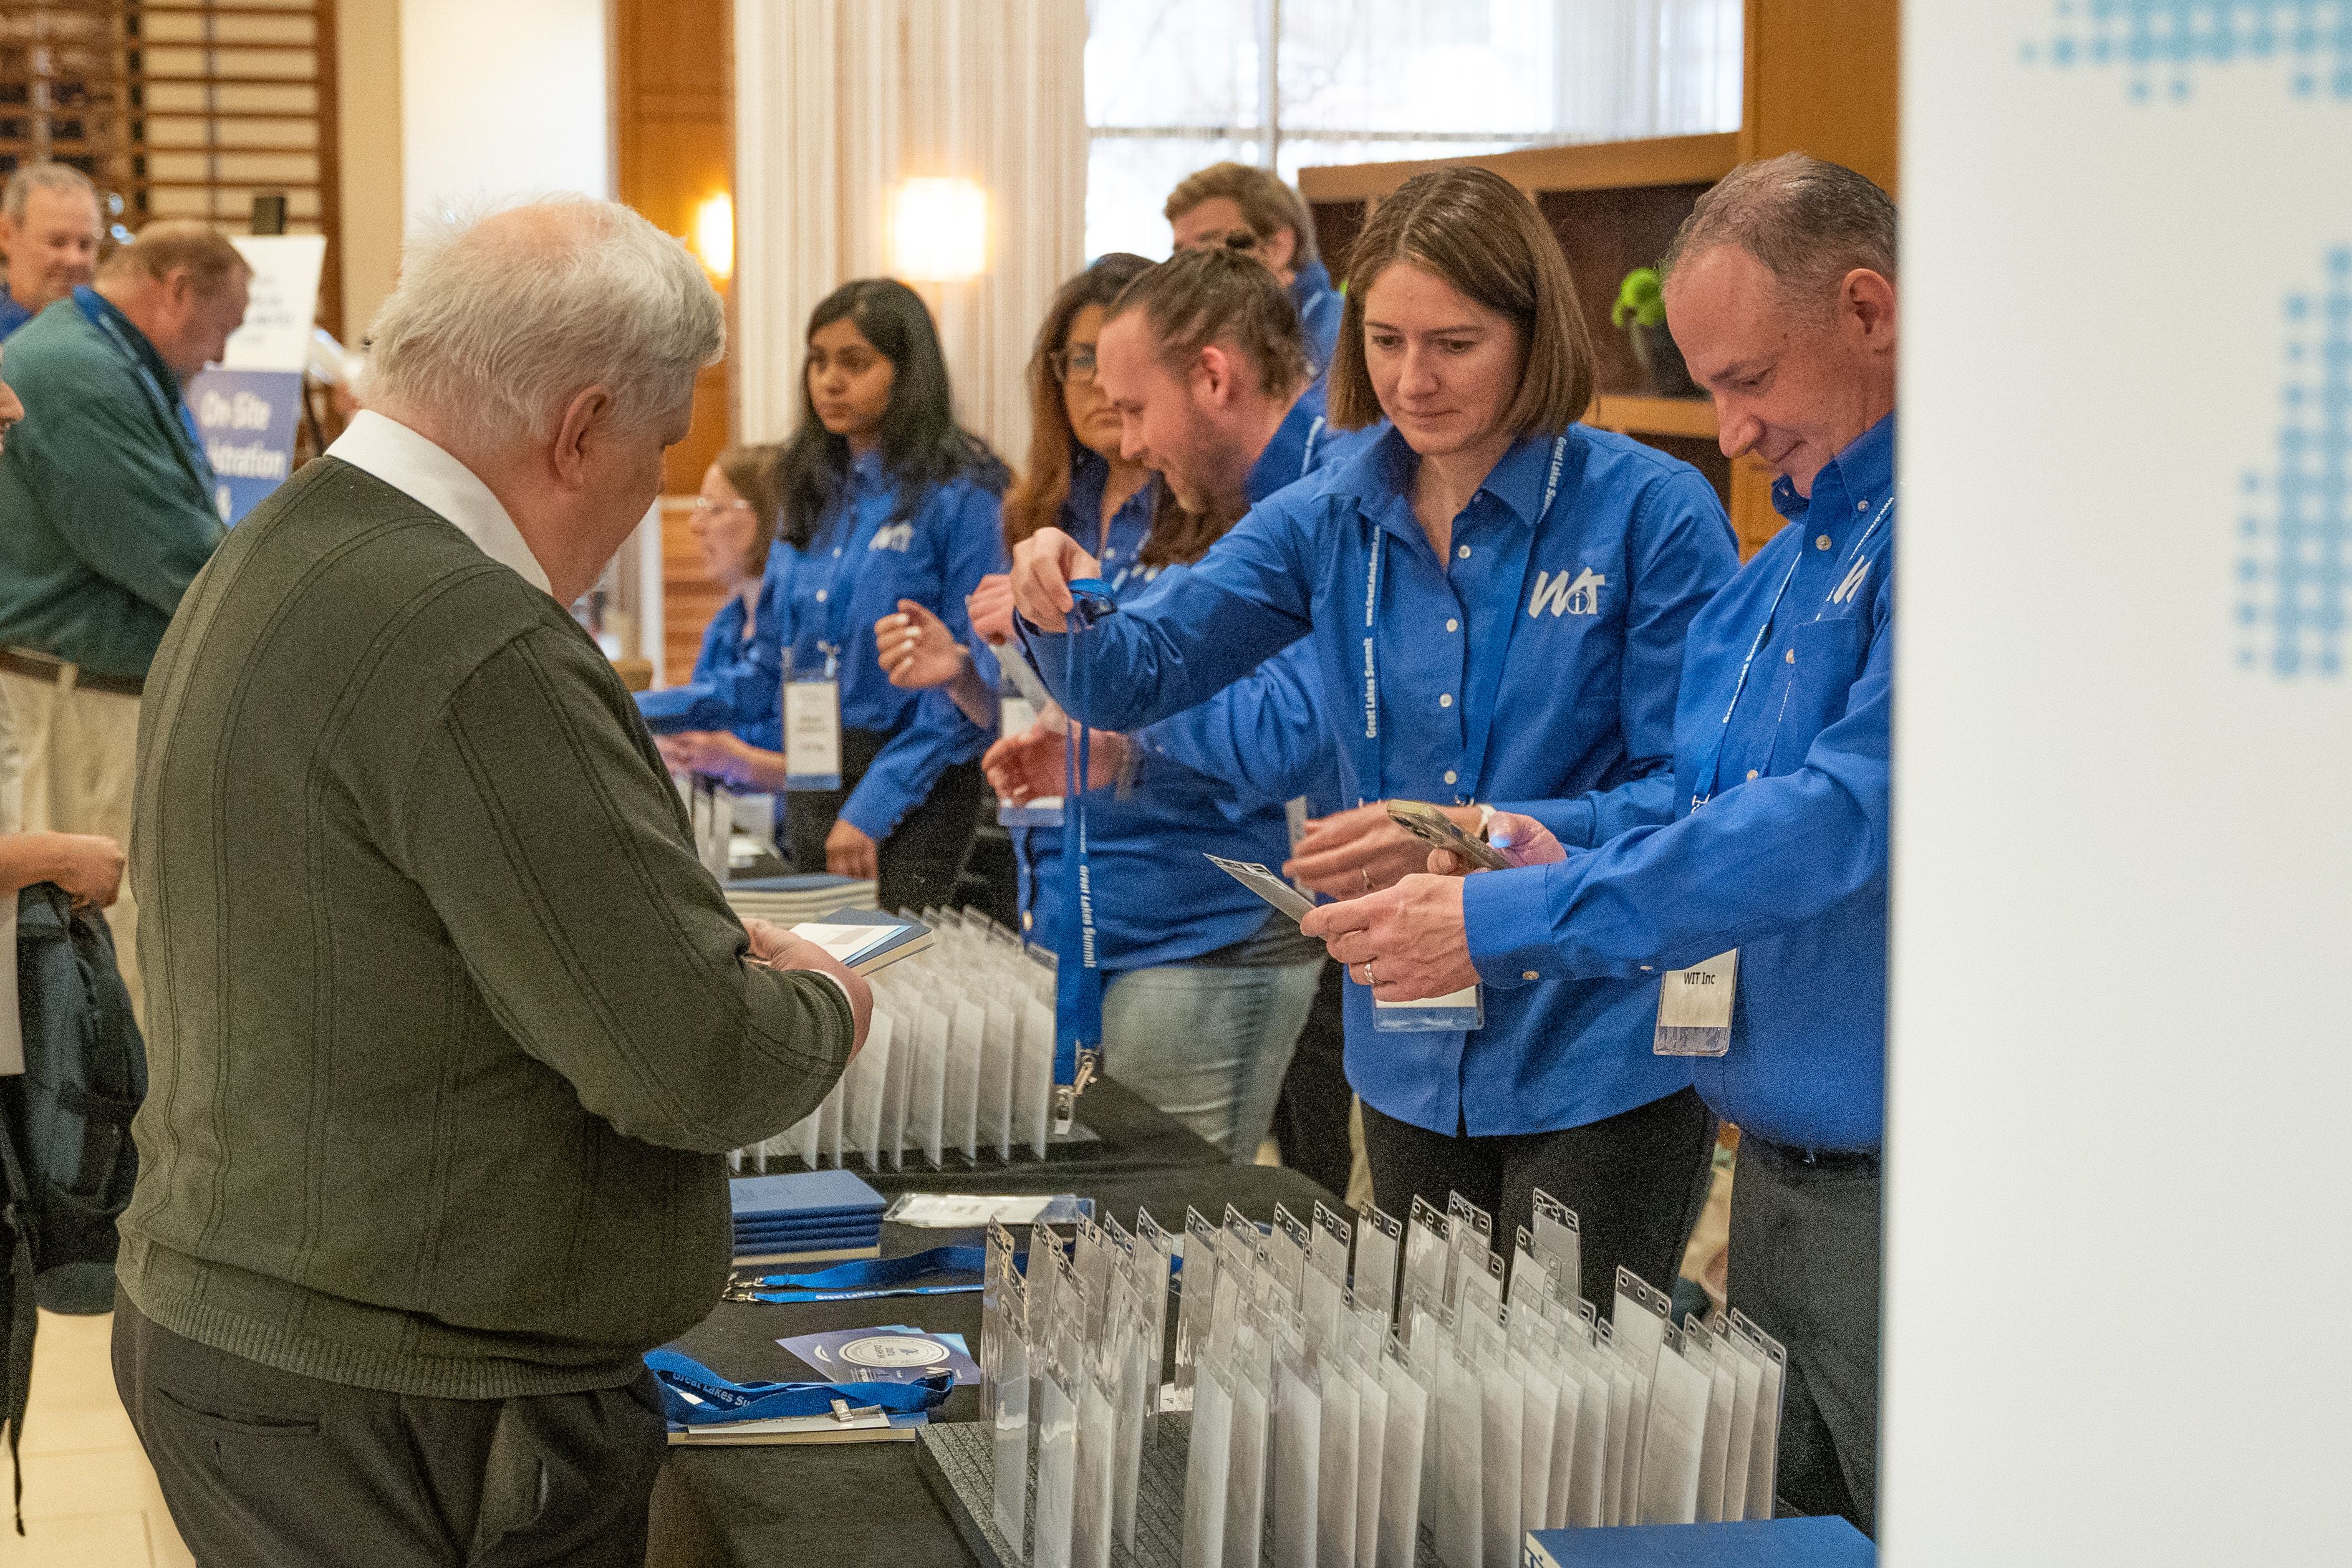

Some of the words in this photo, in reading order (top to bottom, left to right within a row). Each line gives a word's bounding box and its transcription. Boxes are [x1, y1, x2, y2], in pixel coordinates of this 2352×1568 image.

[1363, 638, 1375, 677] Summit
[1364, 678, 1376, 708] Lakes
[1366, 709, 1377, 738] Great
[1079, 865, 1090, 893] Great
[1080, 895, 1093, 926] Lakes
[1082, 927, 1097, 968] Summit
[1684, 972, 1700, 984] WIT
[1701, 972, 1715, 984] Inc
